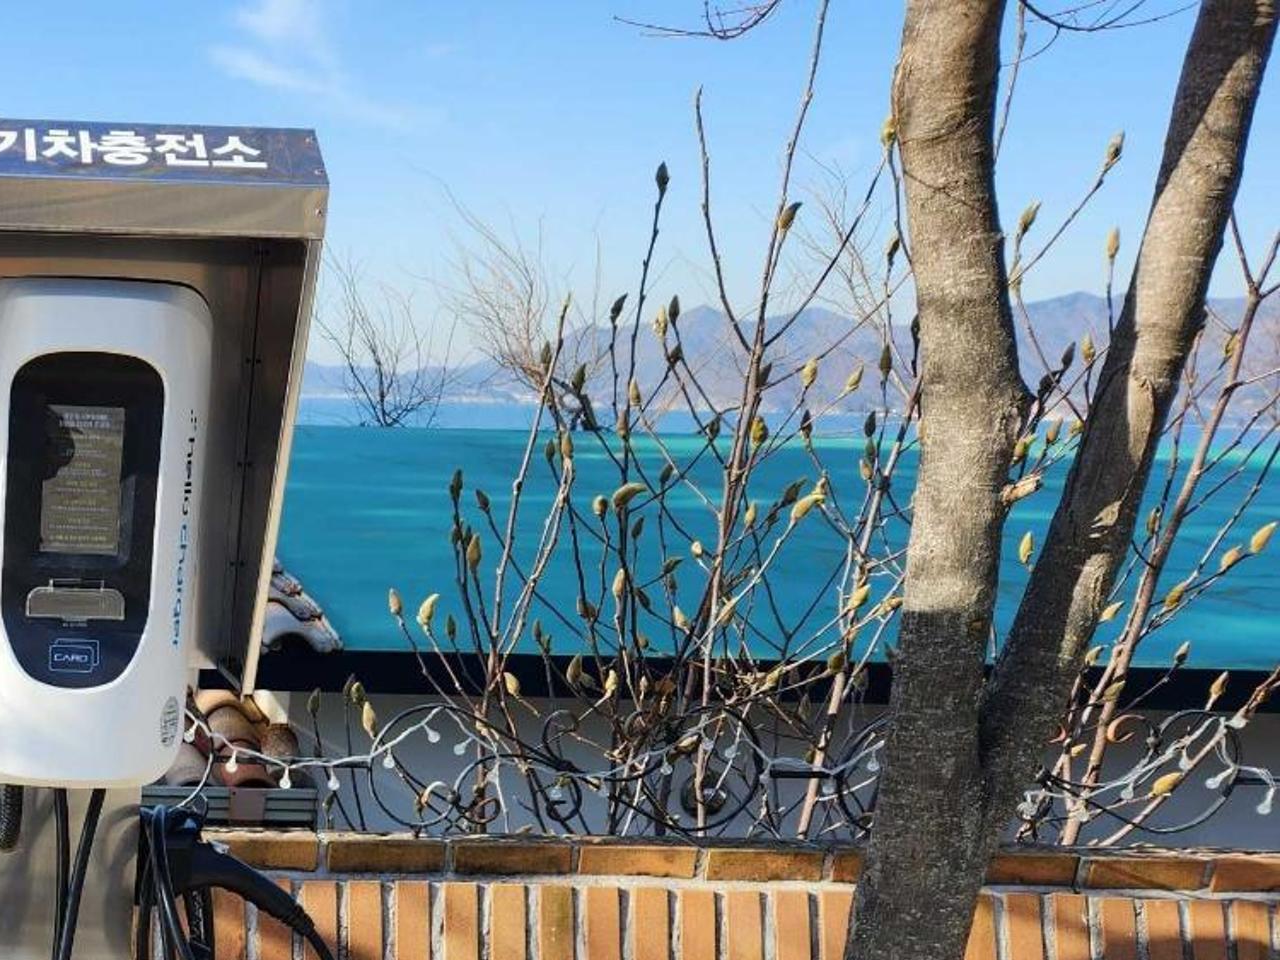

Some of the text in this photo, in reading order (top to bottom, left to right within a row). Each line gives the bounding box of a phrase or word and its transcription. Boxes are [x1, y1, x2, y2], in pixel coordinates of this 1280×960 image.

[173, 437, 196, 647] hello charger
[54, 653, 88, 663] CARD
